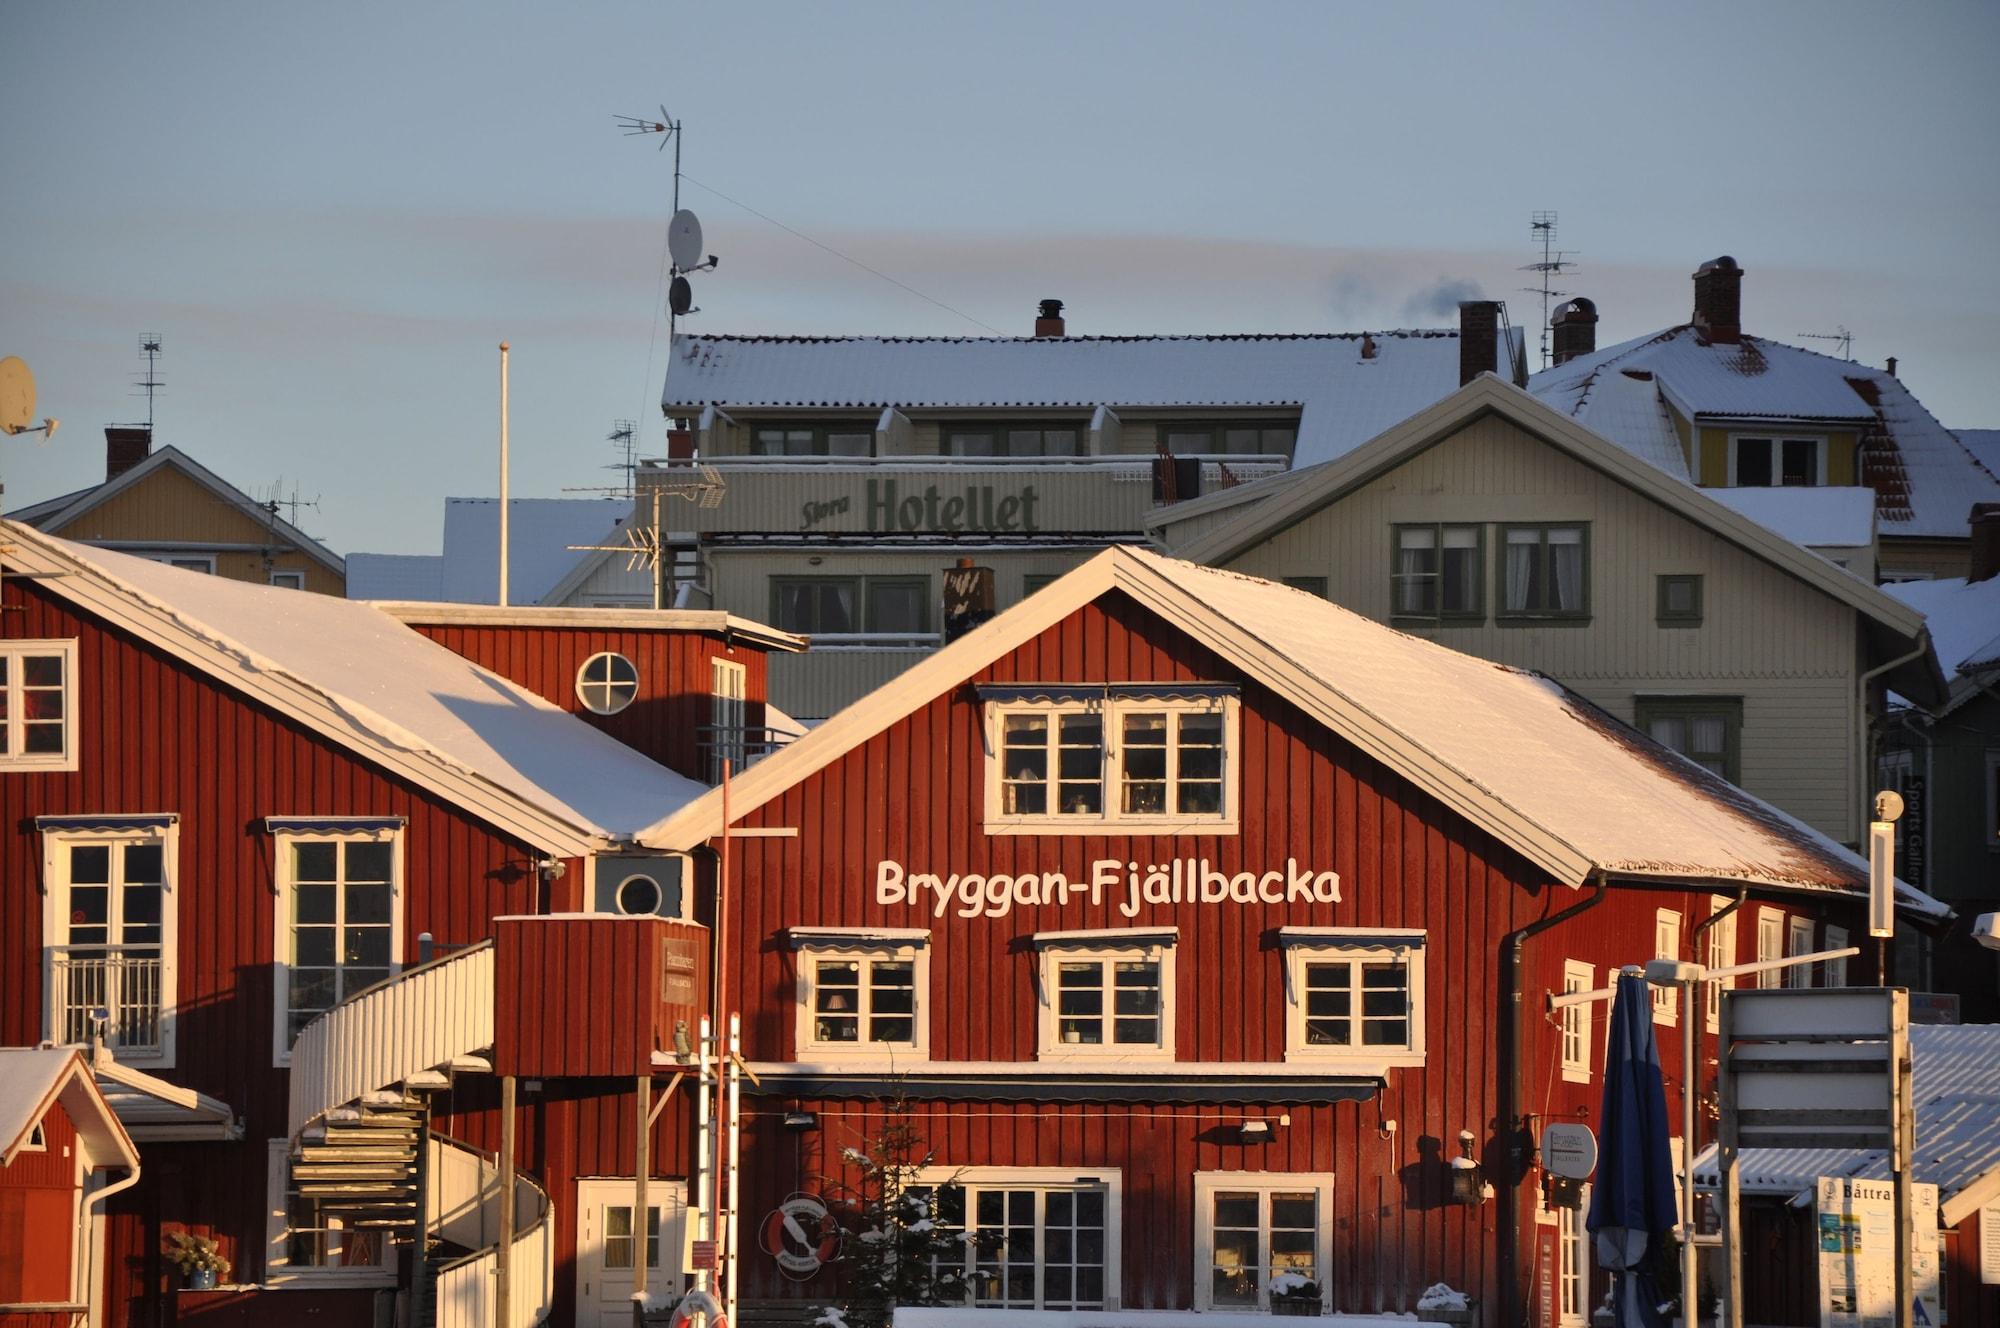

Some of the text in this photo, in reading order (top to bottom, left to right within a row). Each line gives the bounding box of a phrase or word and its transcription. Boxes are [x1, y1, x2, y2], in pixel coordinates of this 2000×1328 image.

[800, 479, 1039, 532] Stora Hotellet
[1905, 781, 1923, 831] Sports
[876, 857, 1342, 918] Bryggan-Fjällbacka
